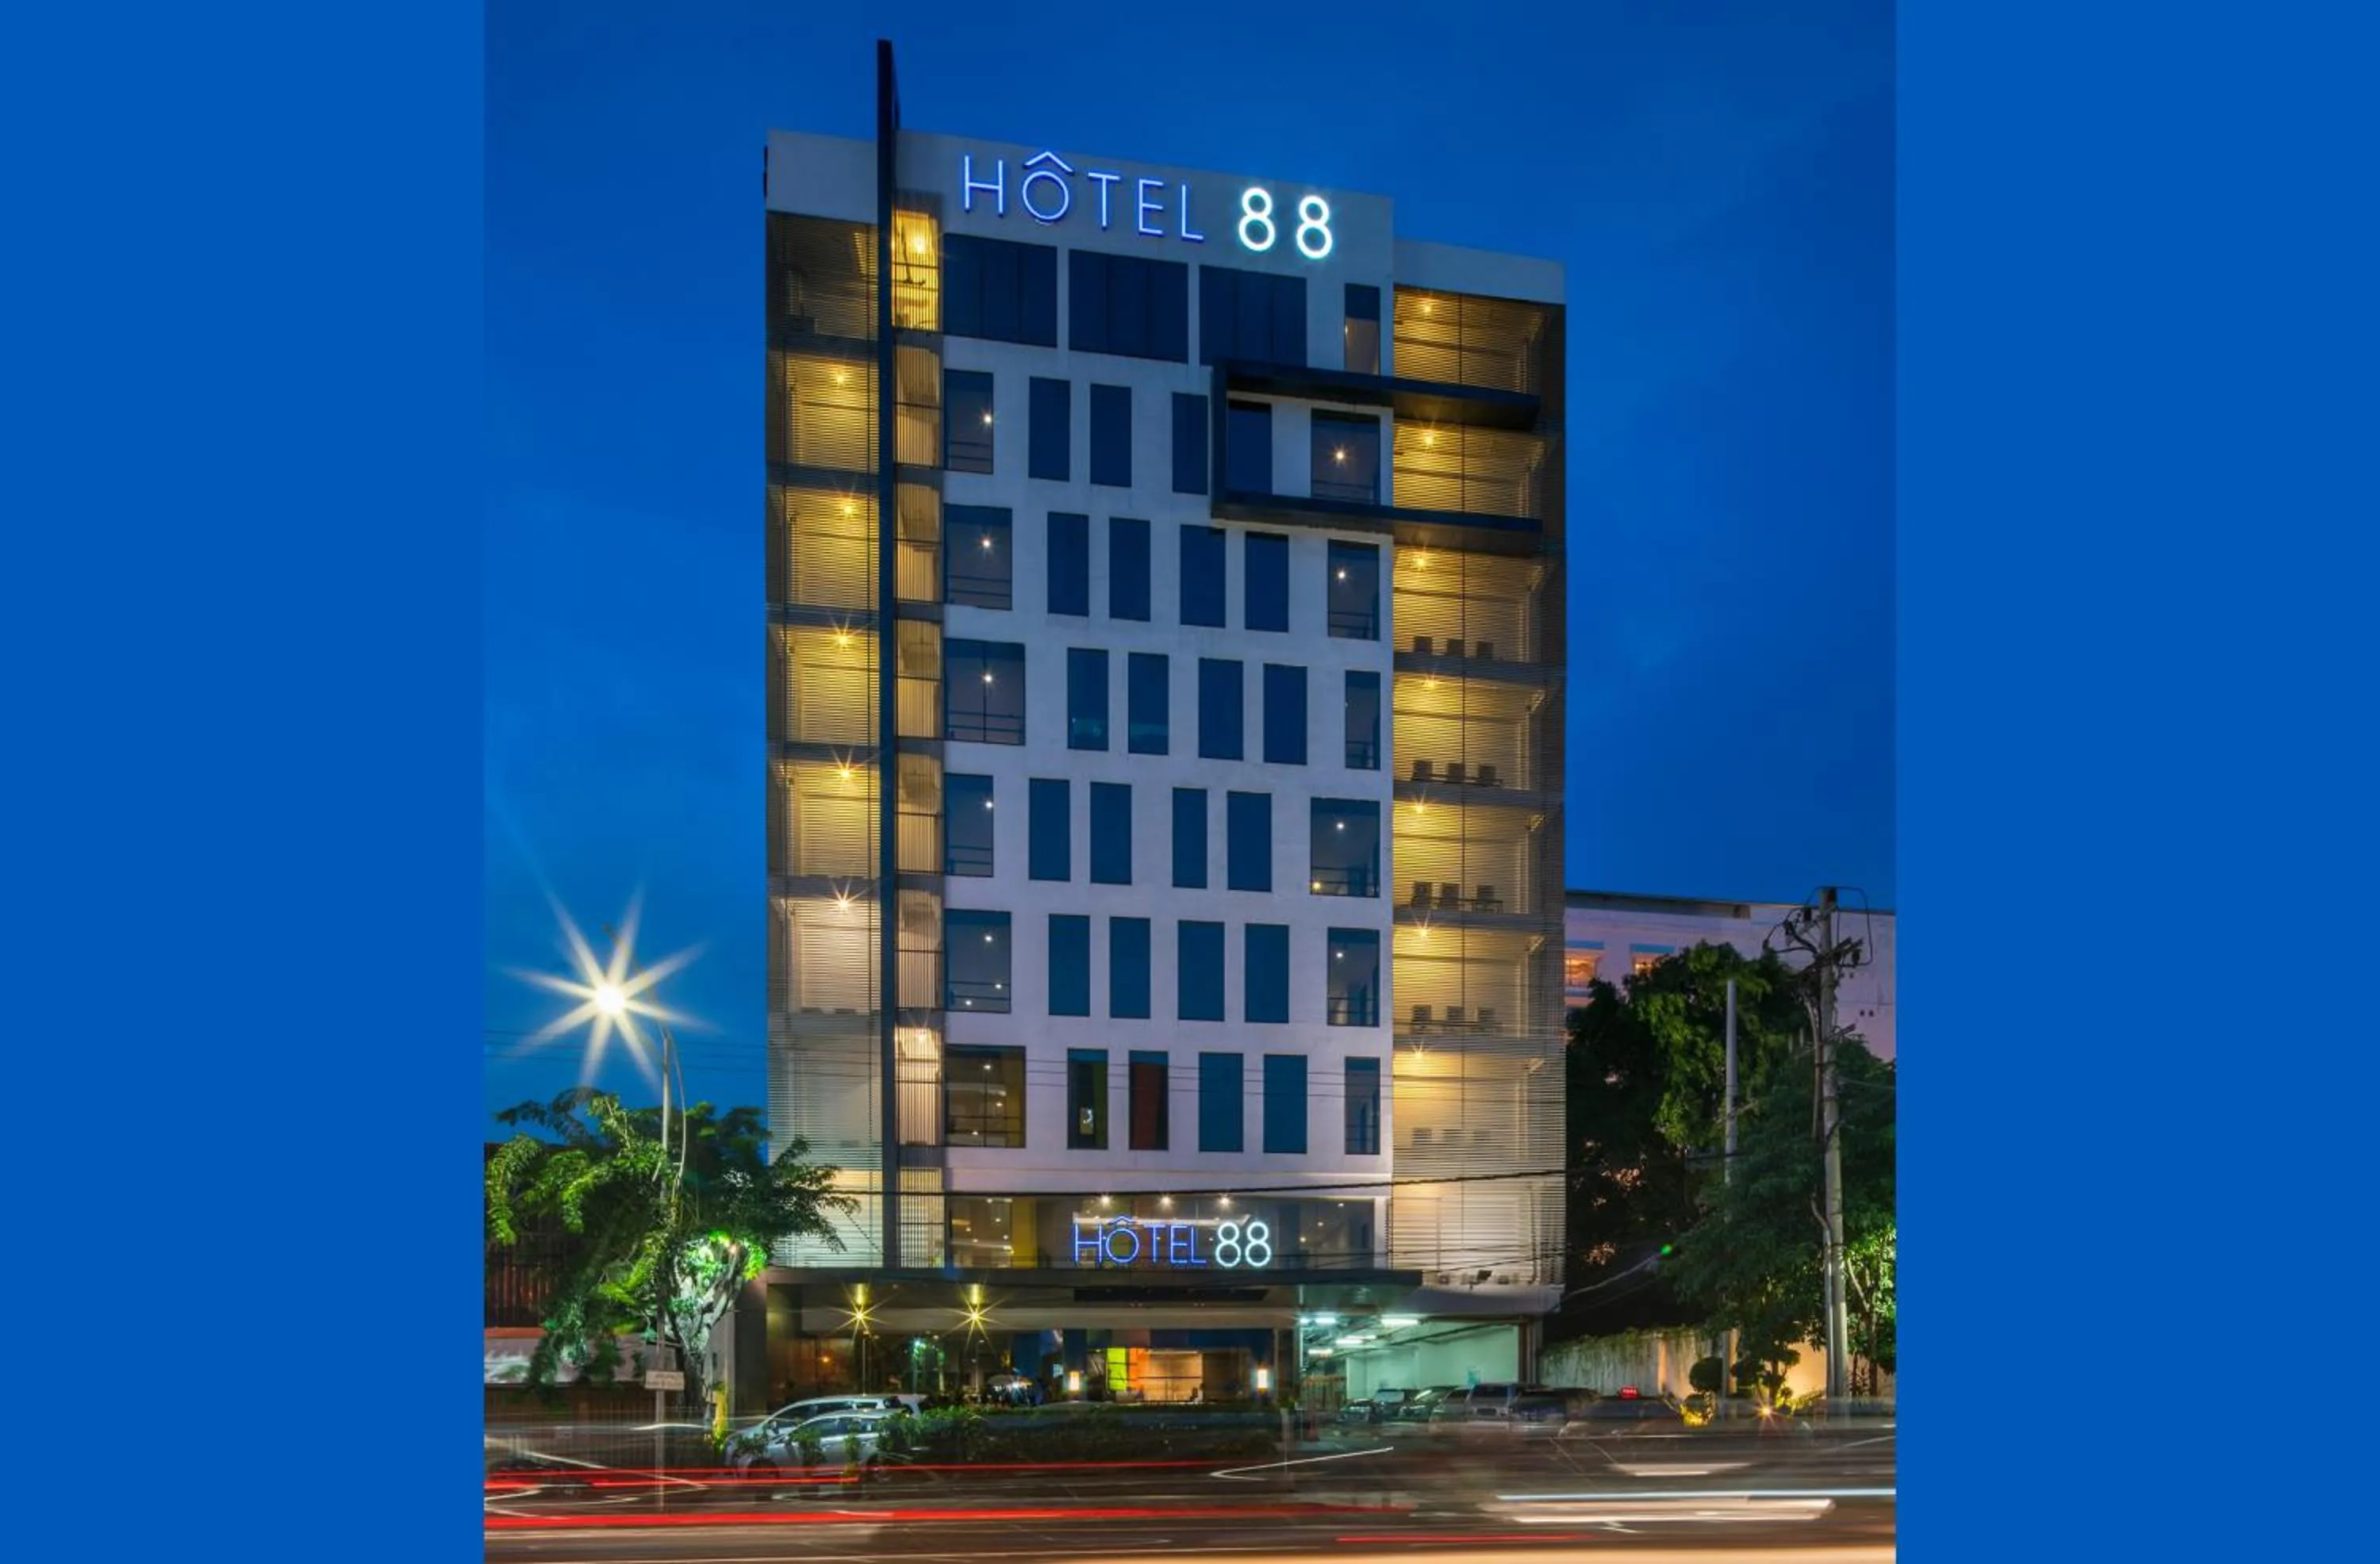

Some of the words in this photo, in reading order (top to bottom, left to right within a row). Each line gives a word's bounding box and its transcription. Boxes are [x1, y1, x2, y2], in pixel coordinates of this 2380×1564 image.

[963, 151, 1203, 241] HÔTEL
[1238, 186, 1334, 260] 88
[1073, 1216, 1207, 1264] HÔTEL
[1215, 1221, 1271, 1267] 88
